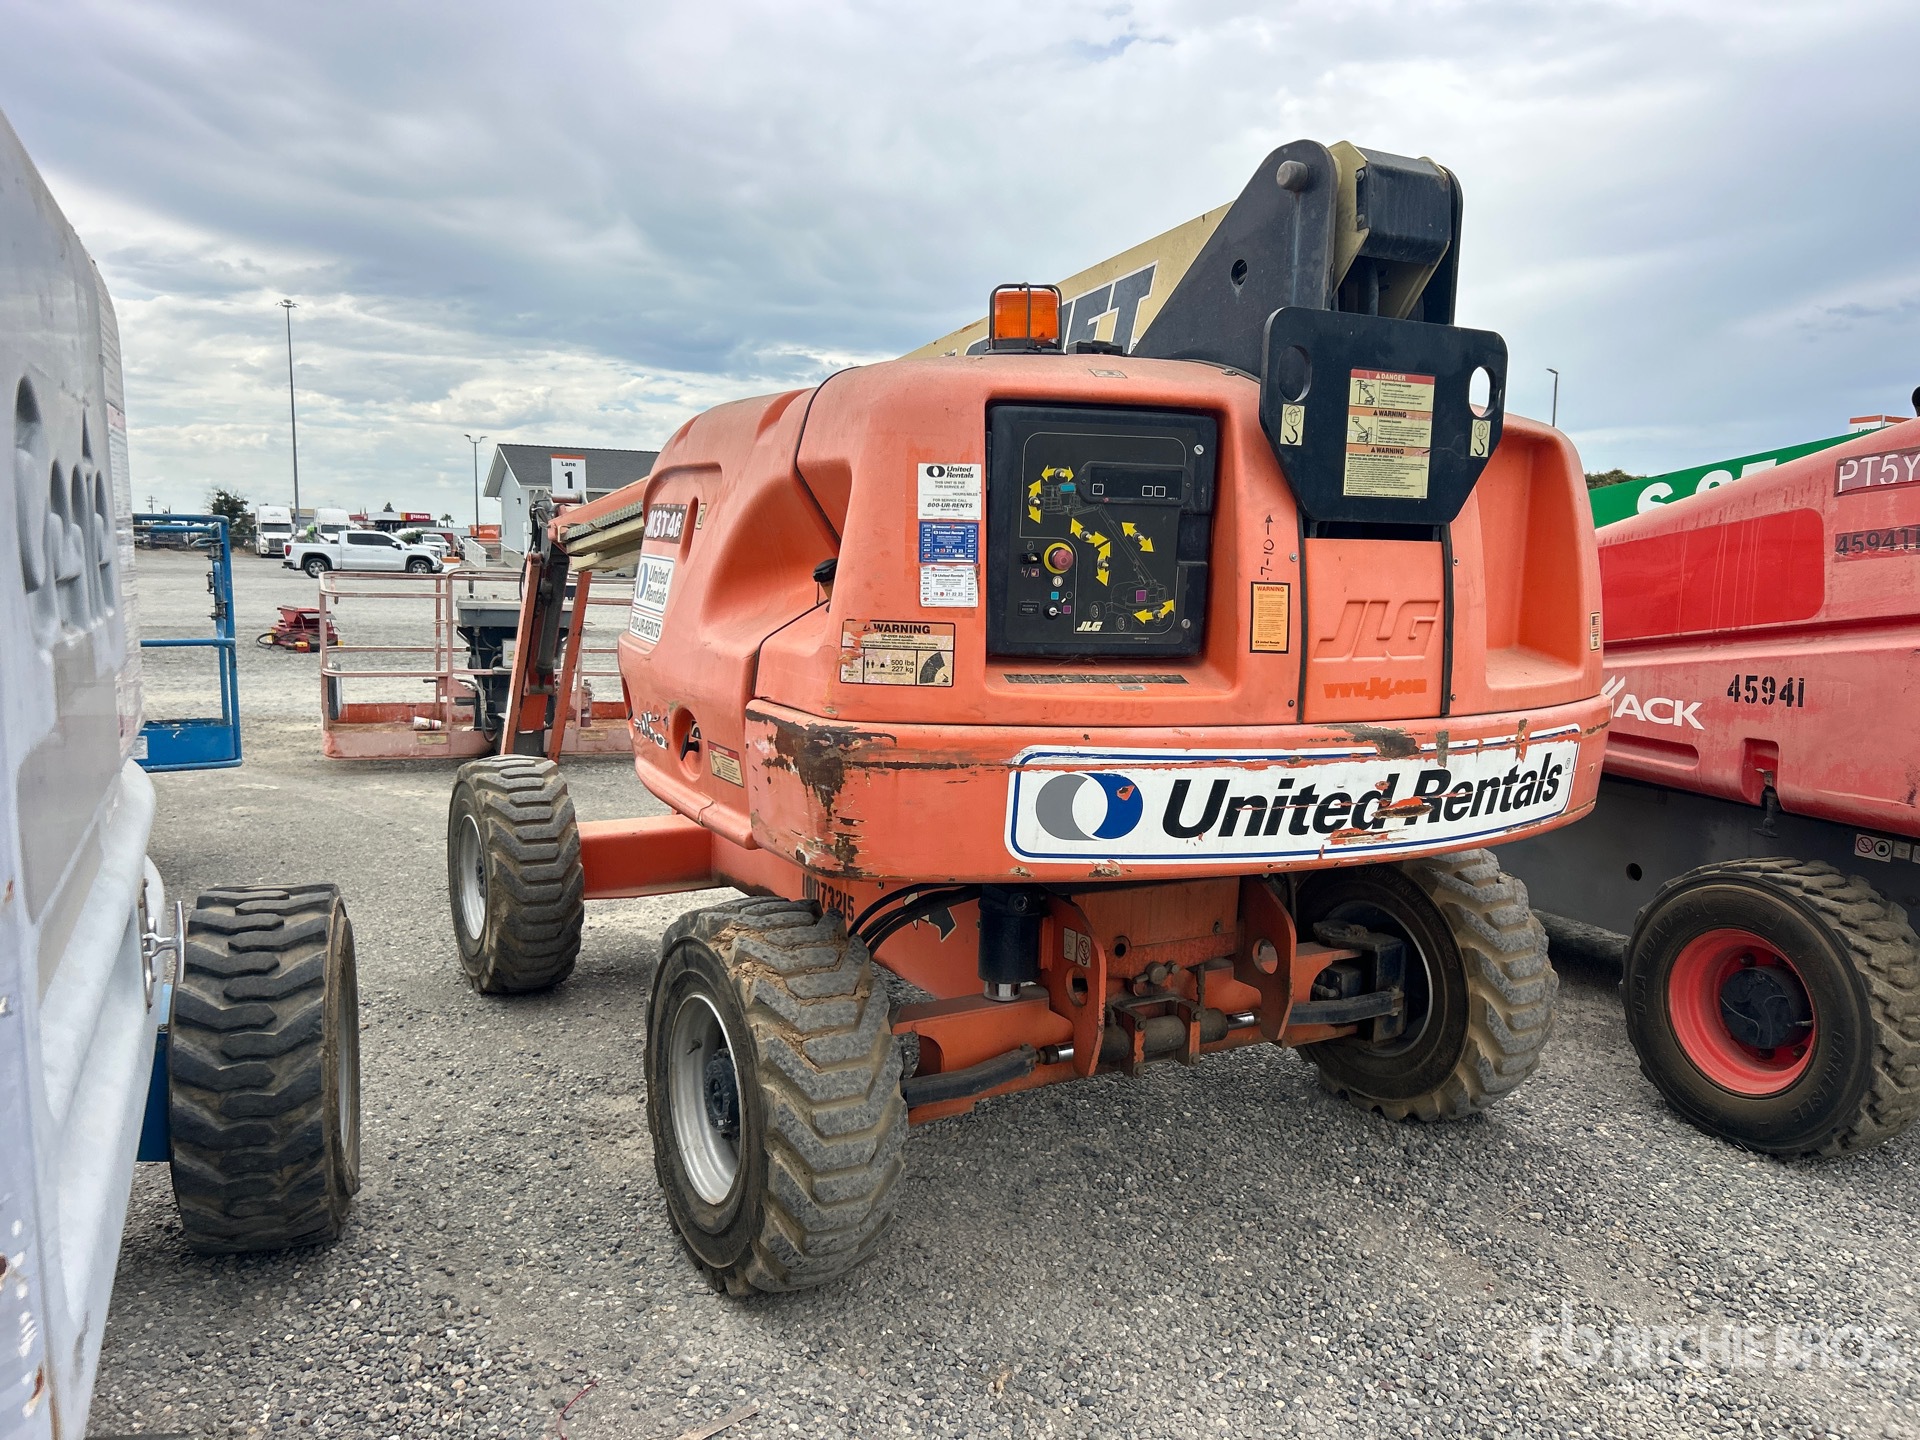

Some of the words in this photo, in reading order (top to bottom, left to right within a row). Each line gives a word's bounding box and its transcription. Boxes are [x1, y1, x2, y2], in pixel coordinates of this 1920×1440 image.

[564, 471, 574, 489] 1
[649, 564, 670, 585] United
[644, 584, 667, 606] Rentals
[874, 624, 930, 634] WARNING
[1076, 621, 1103, 631] JLG
[1312, 600, 1440, 662] JLG
[1162, 773, 1400, 839] United
[1403, 752, 1563, 826] Rentals
